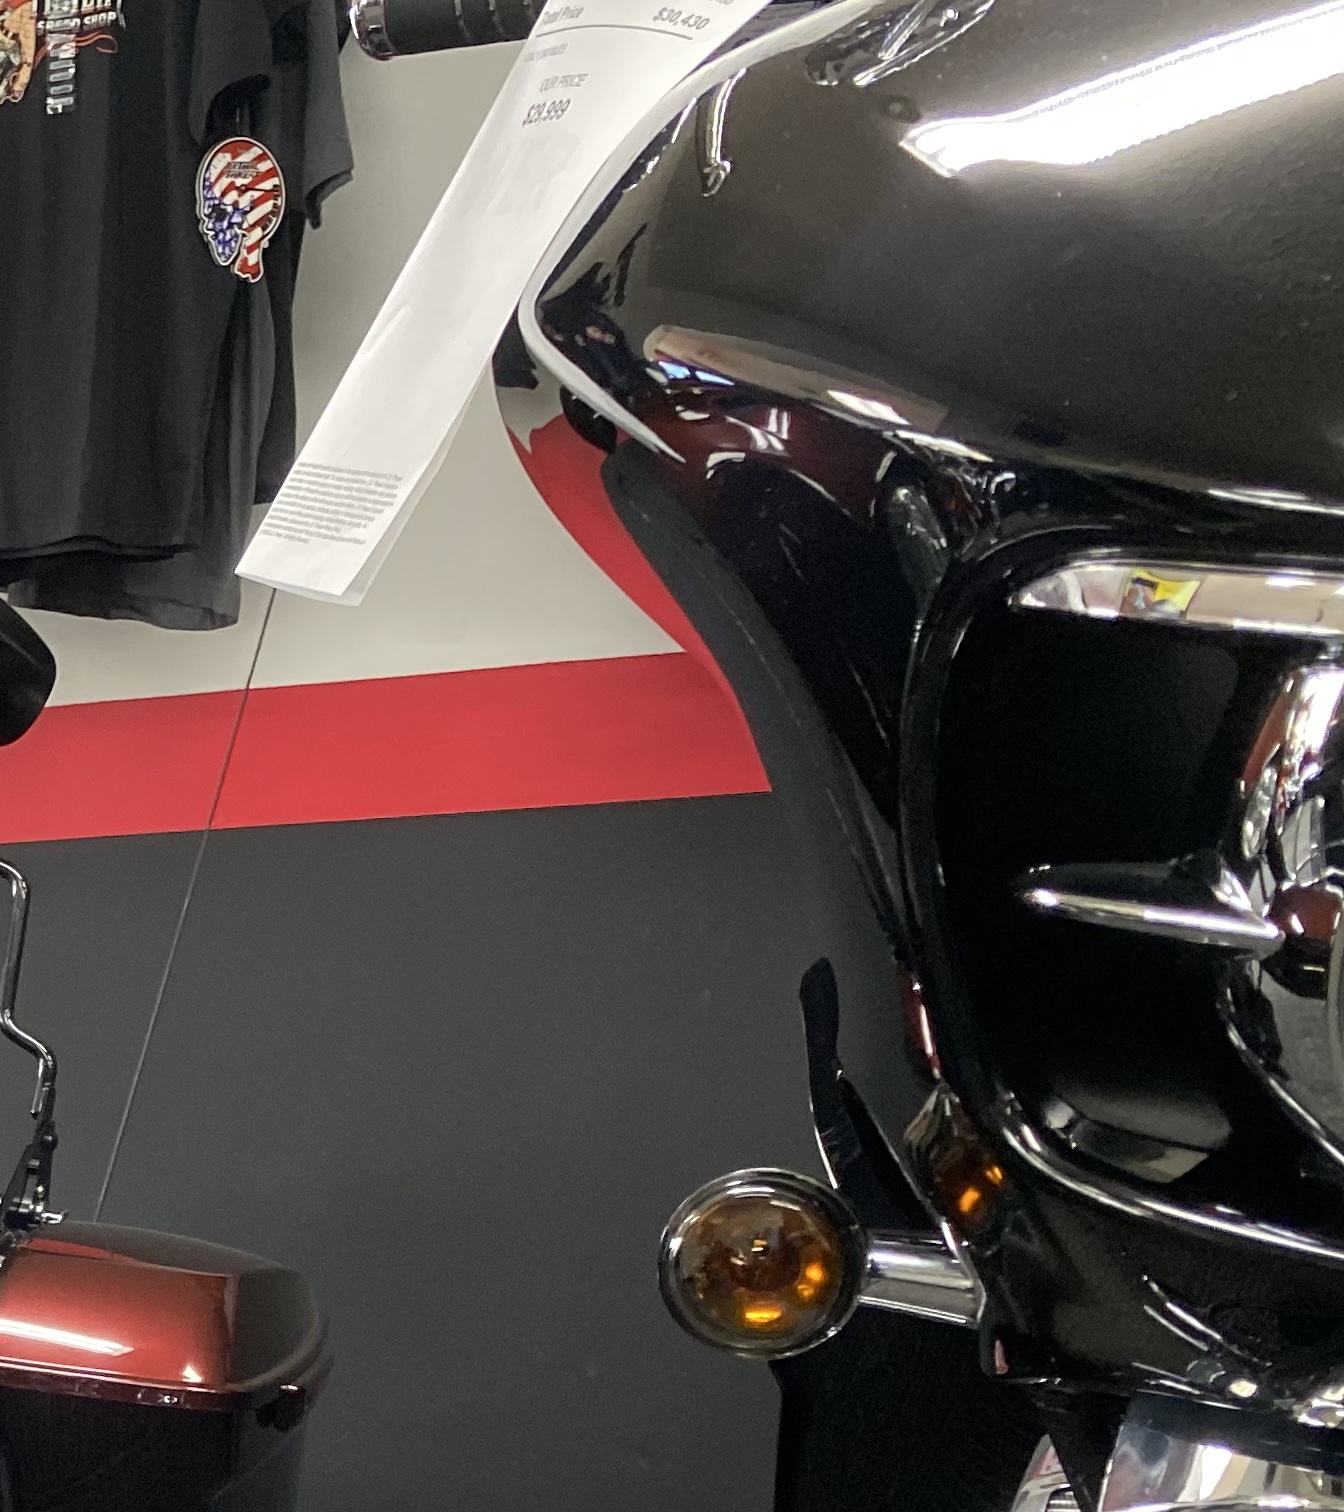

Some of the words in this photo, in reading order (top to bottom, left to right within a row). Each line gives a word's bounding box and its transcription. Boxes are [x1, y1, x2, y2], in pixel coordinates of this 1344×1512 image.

[83, 11, 117, 31] SHOP
[652, 7, 711, 31] $30,430
[521, 98, 571, 128] $29,999
